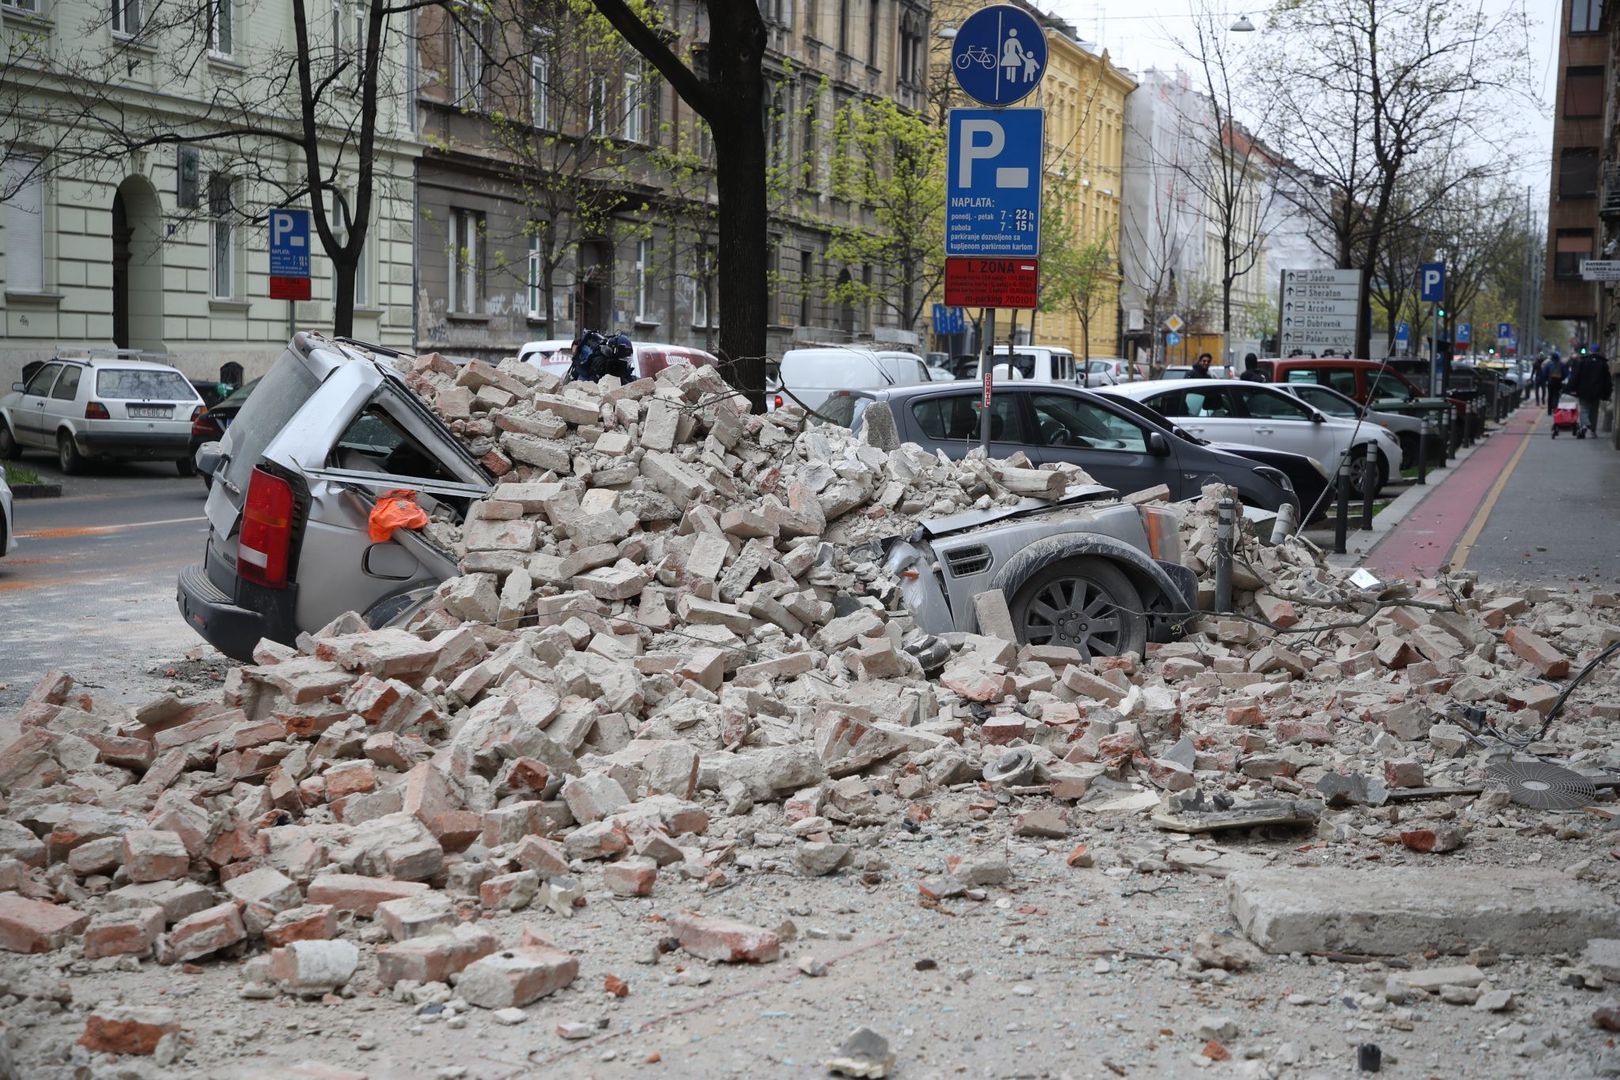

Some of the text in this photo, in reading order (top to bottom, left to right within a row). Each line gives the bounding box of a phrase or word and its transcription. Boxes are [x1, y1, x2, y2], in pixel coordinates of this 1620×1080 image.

[959, 119, 1006, 188] P
[951, 197, 995, 208] NAPLATA:
[951, 213, 973, 221] ponedj.
[977, 213, 994, 221] petak
[1000, 210, 1007, 220] 7
[1015, 209, 1028, 220] 22
[1028, 211, 1034, 220] h
[274, 213, 294, 246] P
[1000, 222, 1006, 231] 7
[1015, 221, 1027, 231] 15
[1028, 222, 1034, 232] h
[950, 233, 980, 242] parkiranje
[981, 233, 1013, 242] dozvoljeno
[950, 242, 1033, 251] kupljenom parkirnom kartom
[980, 261, 1015, 273] ZONA
[1424, 270, 1440, 294] P
[1308, 289, 1341, 297] Sheraton
[1005, 295, 1033, 304] 700101
[1306, 320, 1341, 328] Dubrovnik
[1306, 334, 1329, 342] Palace
